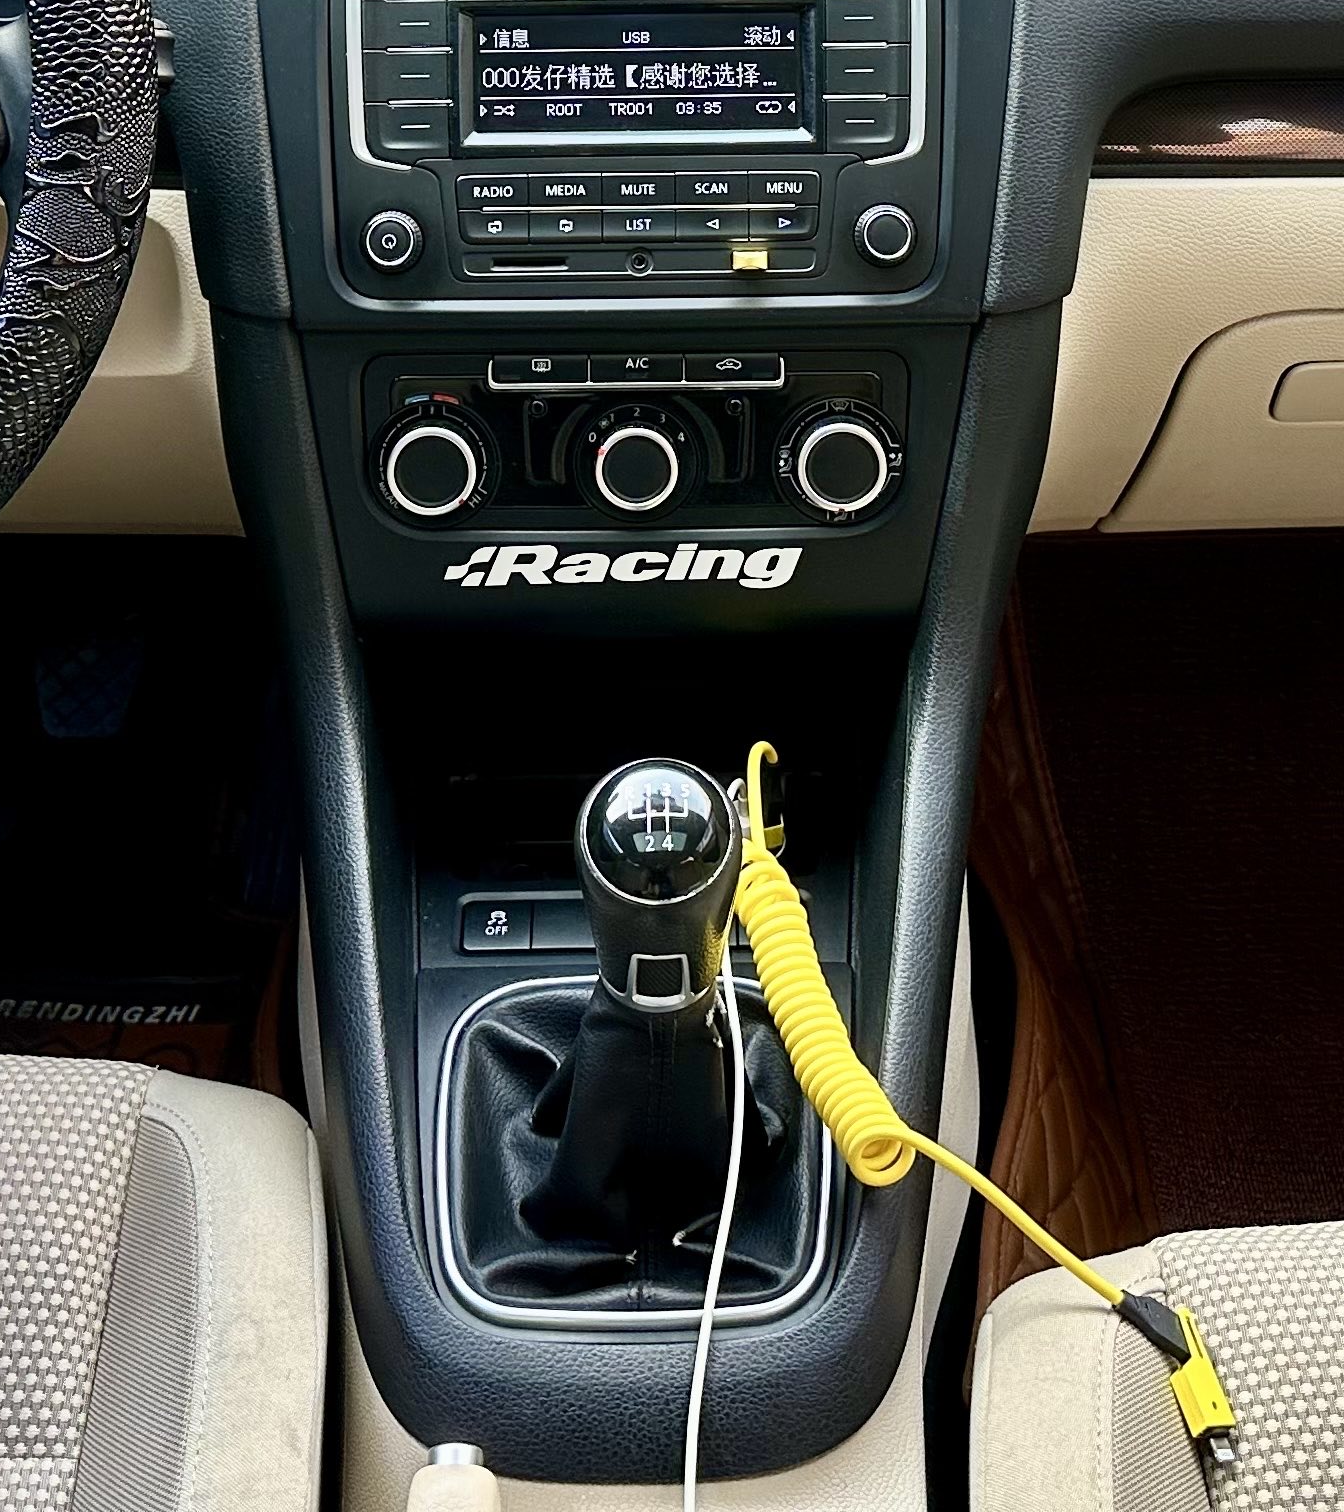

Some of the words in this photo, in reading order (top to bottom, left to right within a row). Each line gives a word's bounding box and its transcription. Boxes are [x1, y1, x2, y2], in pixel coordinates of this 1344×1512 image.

[493, 29, 529, 48] 信息
[622, 32, 650, 44] USB
[744, 26, 781, 46] 滚动
[546, 103, 583, 116] ROOT
[609, 103, 653, 116] TR001
[473, 185, 514, 198] RADIO
[545, 184, 586, 197] MEDIA
[621, 183, 656, 196] MUTE
[694, 182, 728, 195] SCAN
[766, 181, 802, 194] MENU
[626, 218, 651, 231] LIST
[625, 357, 650, 369] A/C
[588, 432, 596, 442] 0
[633, 407, 641, 417] 2
[659, 413, 666, 423] 3
[677, 431, 685, 442] 4
[487, 542, 803, 589] Racing
[645, 835, 655, 852] 2
[662, 834, 674, 852] 4
[485, 926, 508, 935] OFF
